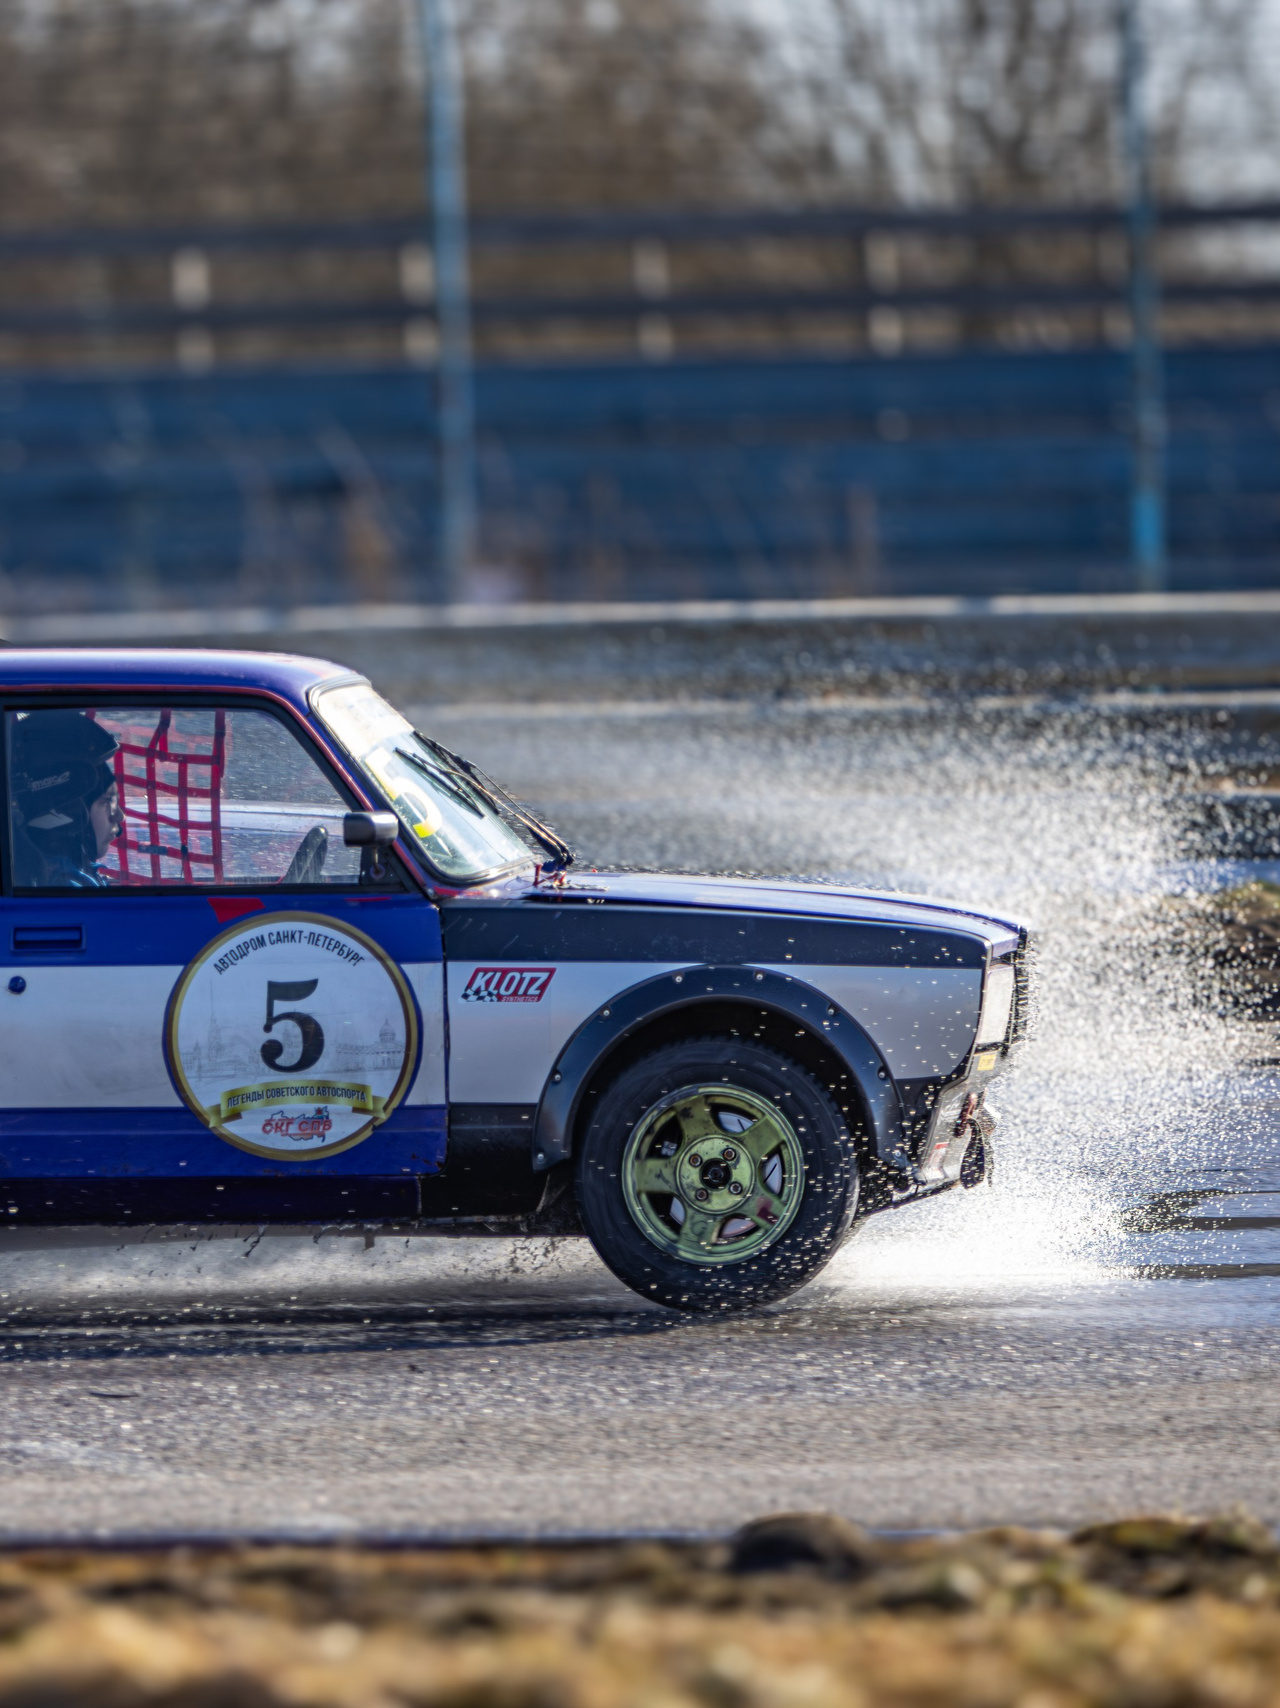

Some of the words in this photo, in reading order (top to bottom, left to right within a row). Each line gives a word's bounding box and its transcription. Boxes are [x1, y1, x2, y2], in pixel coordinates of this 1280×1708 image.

[213, 934, 267, 975] АВТОДРОМ
[268, 930, 366, 967] САНКТ-ПЕТЕРБУРГ
[471, 972, 551, 996] KLOTZ
[260, 978, 325, 1073] 5
[227, 1088, 265, 1108] ЛЕГЕНДЫ
[266, 1086, 315, 1099] СОВЕТСКОГО
[316, 1086, 367, 1102] АВТОСПОРТА
